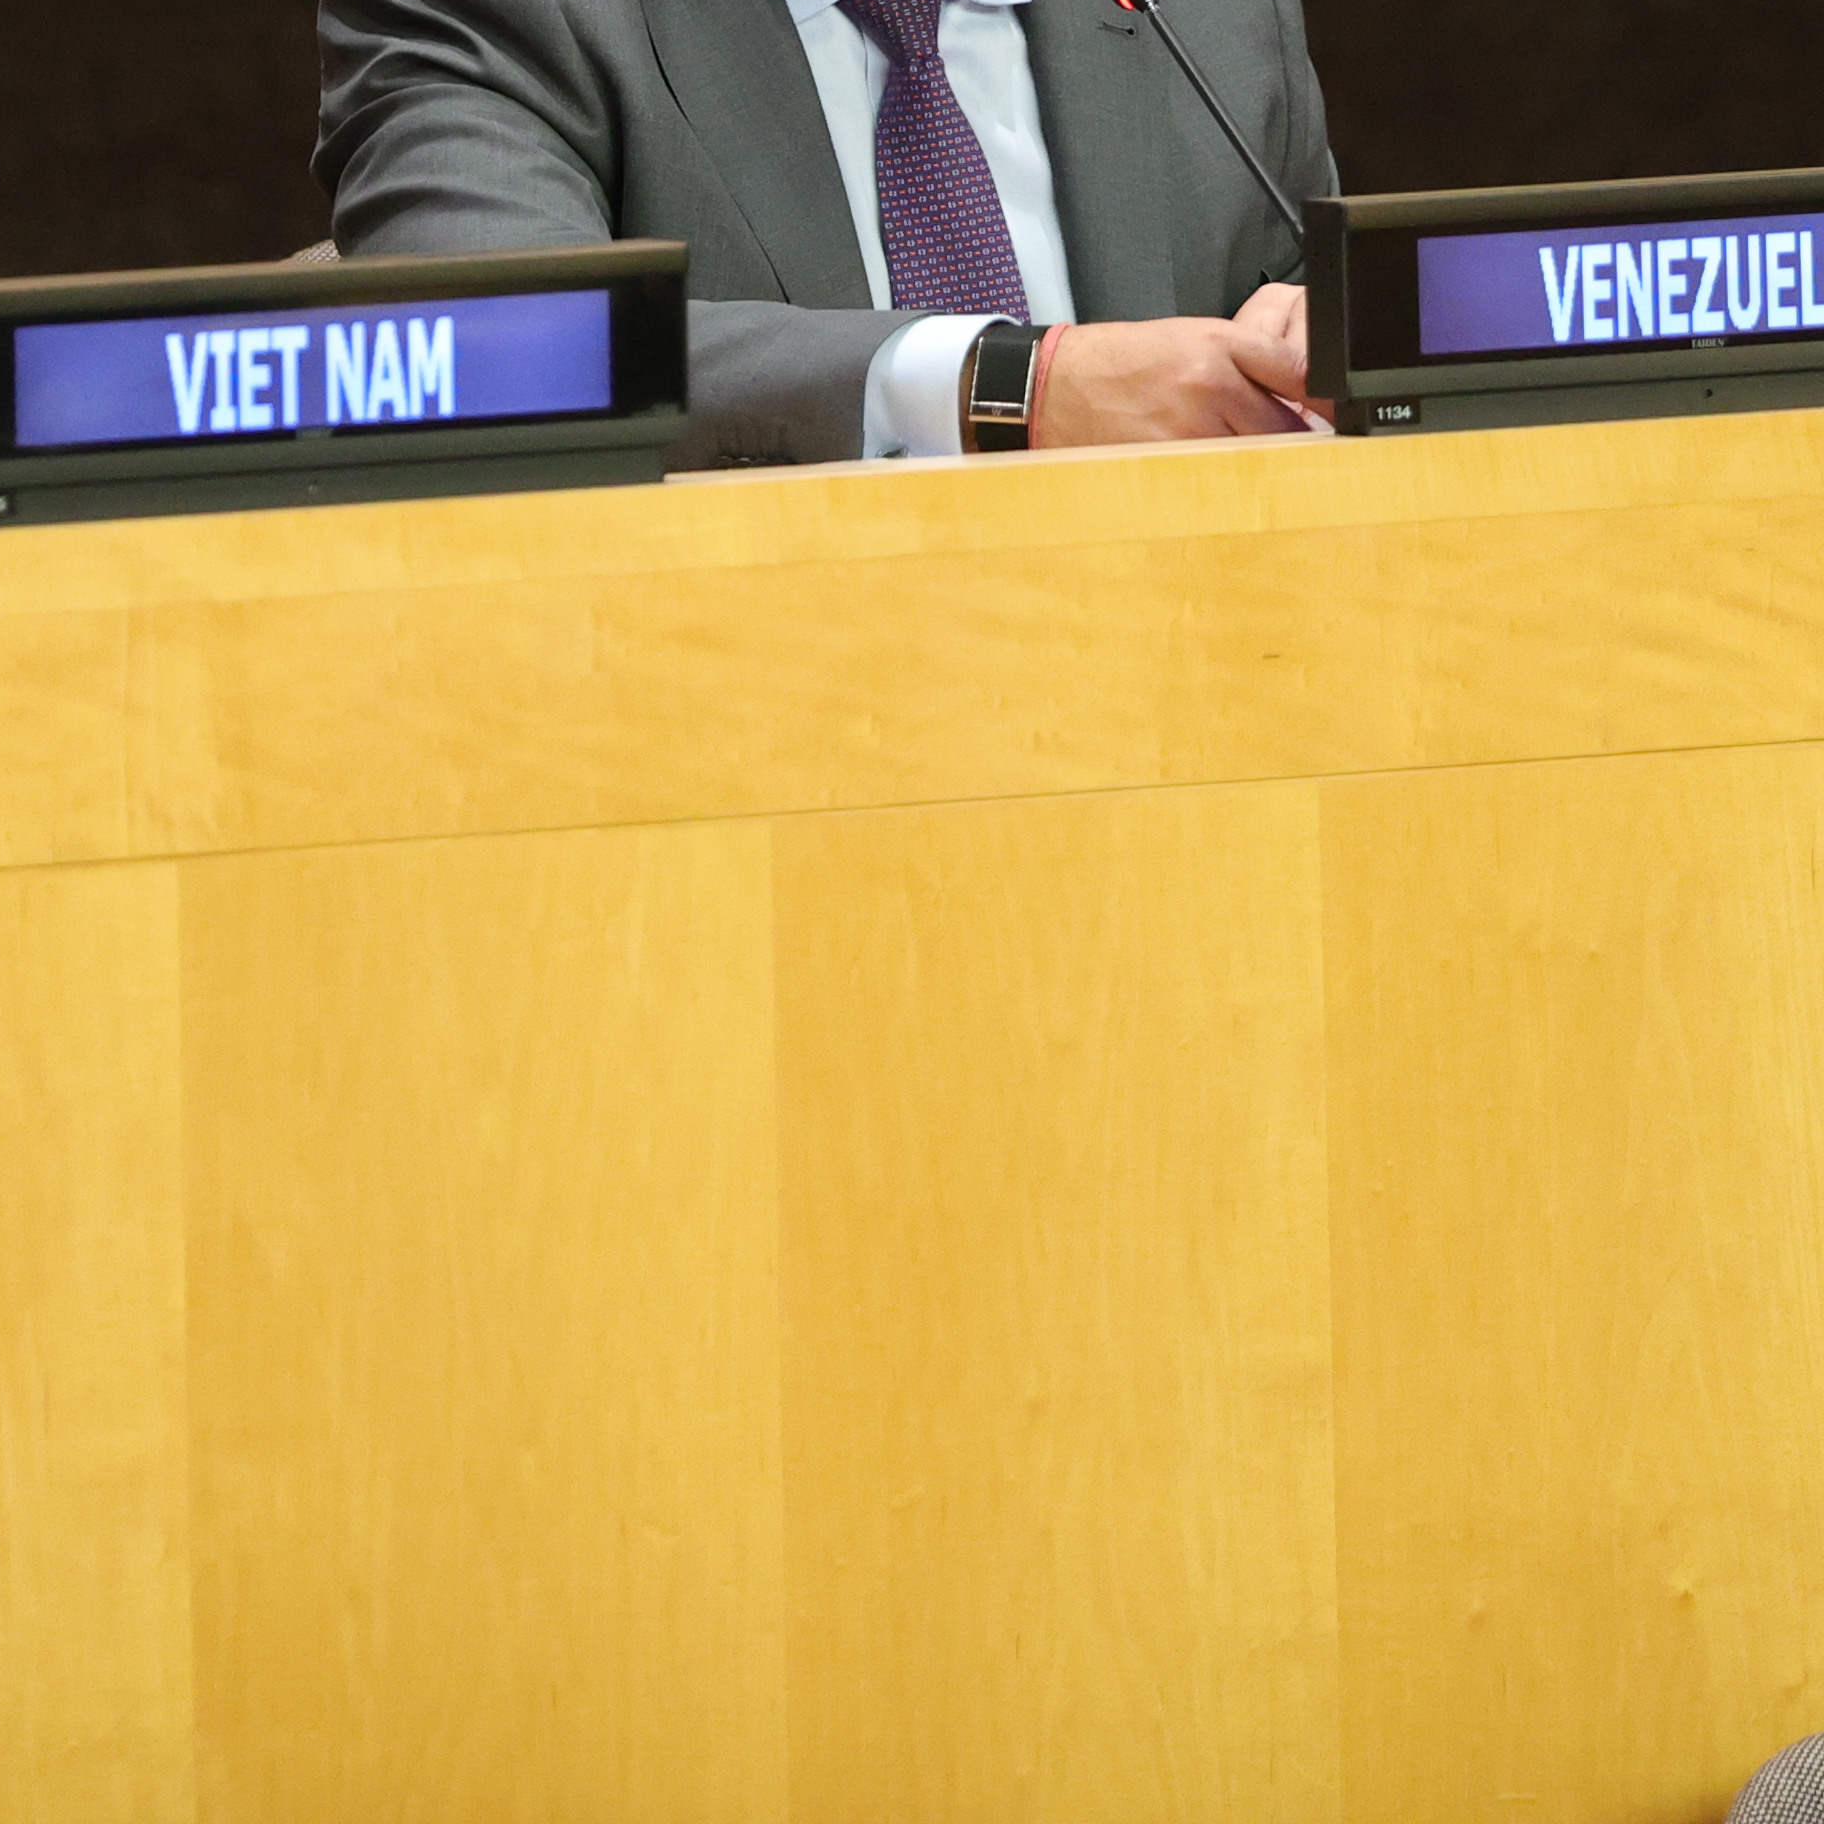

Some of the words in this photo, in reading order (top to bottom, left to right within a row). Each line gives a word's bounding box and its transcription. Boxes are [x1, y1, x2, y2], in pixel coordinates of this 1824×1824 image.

[164, 325, 310, 435] VIET
[324, 315, 456, 426] NAM
[1376, 405, 1411, 421] 1134
